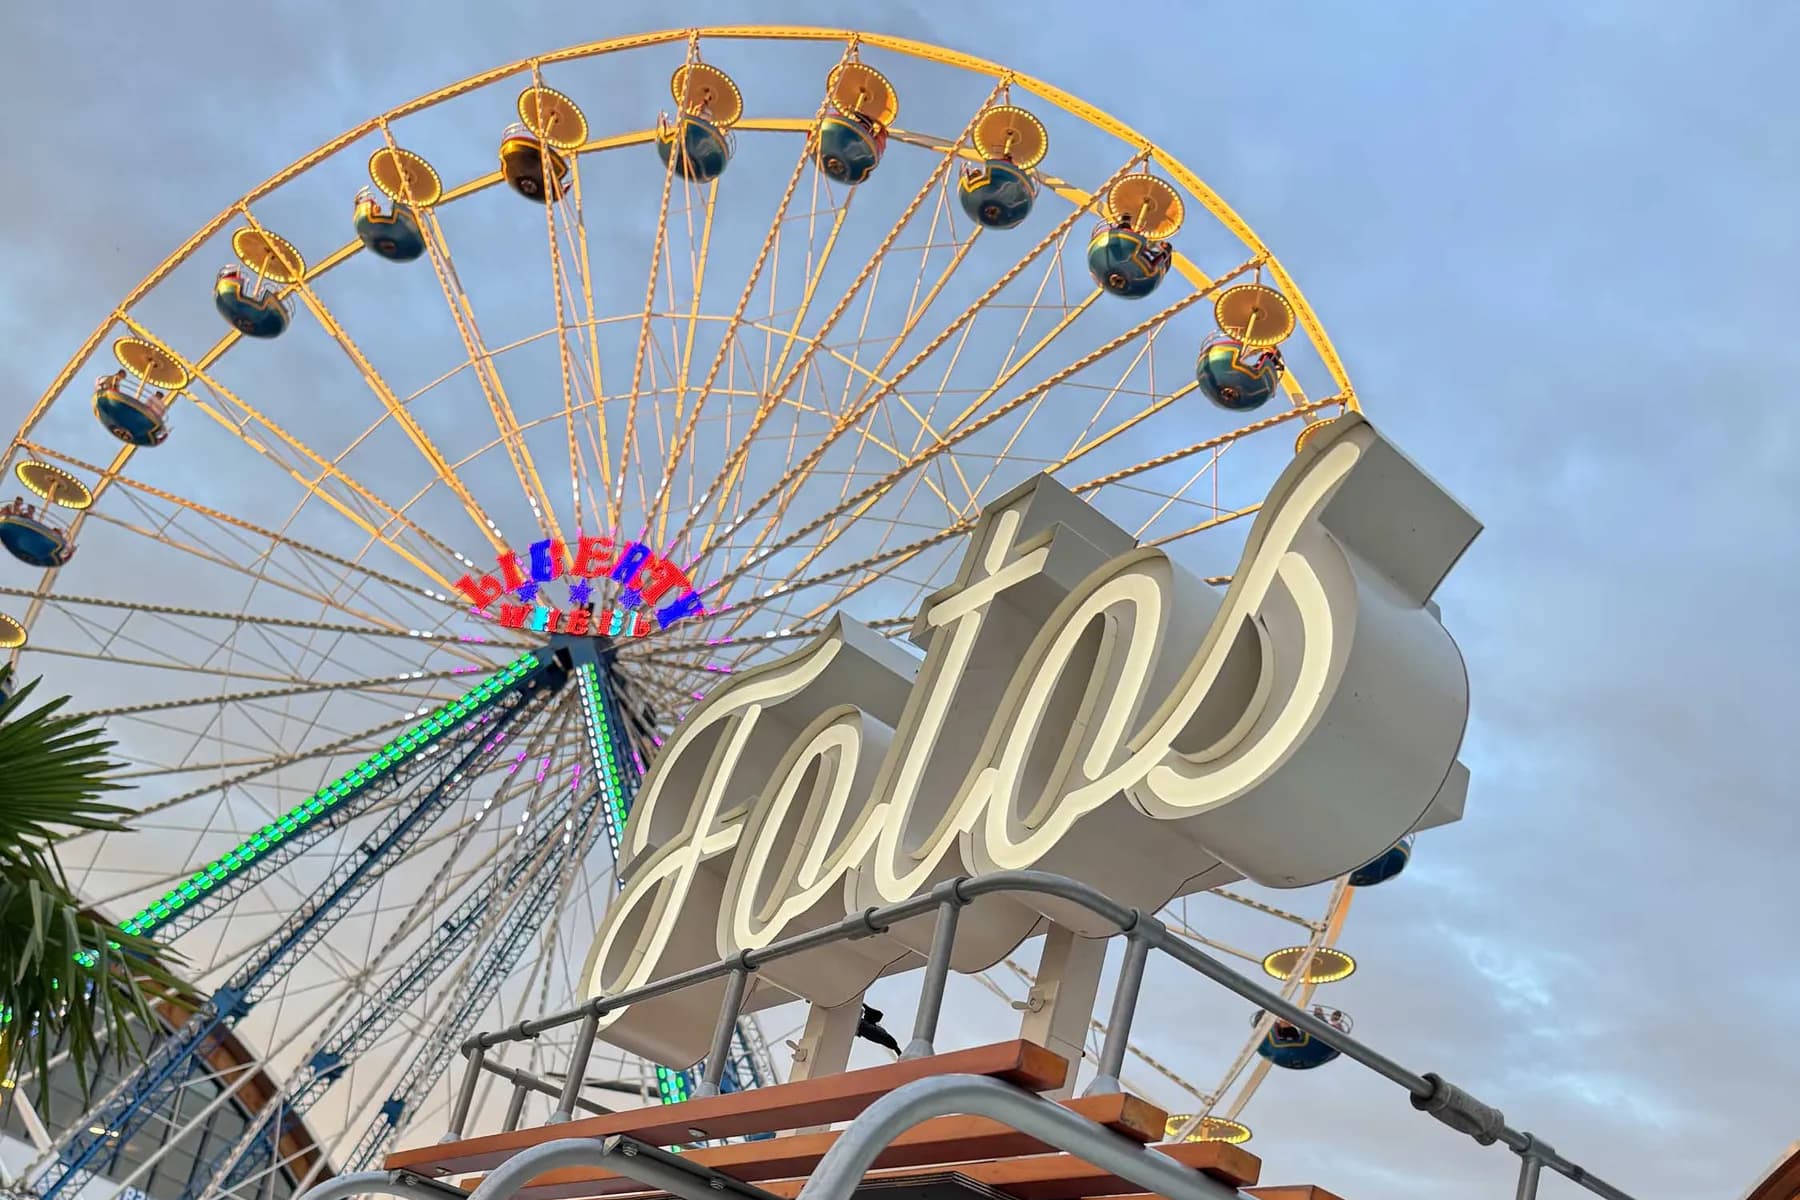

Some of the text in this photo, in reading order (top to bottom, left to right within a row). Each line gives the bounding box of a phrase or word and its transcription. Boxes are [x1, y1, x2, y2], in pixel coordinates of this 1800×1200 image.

[454, 536, 705, 631] LIBERTY
[499, 603, 651, 638] WHEEL
[590, 441, 1361, 1029] Fotos
